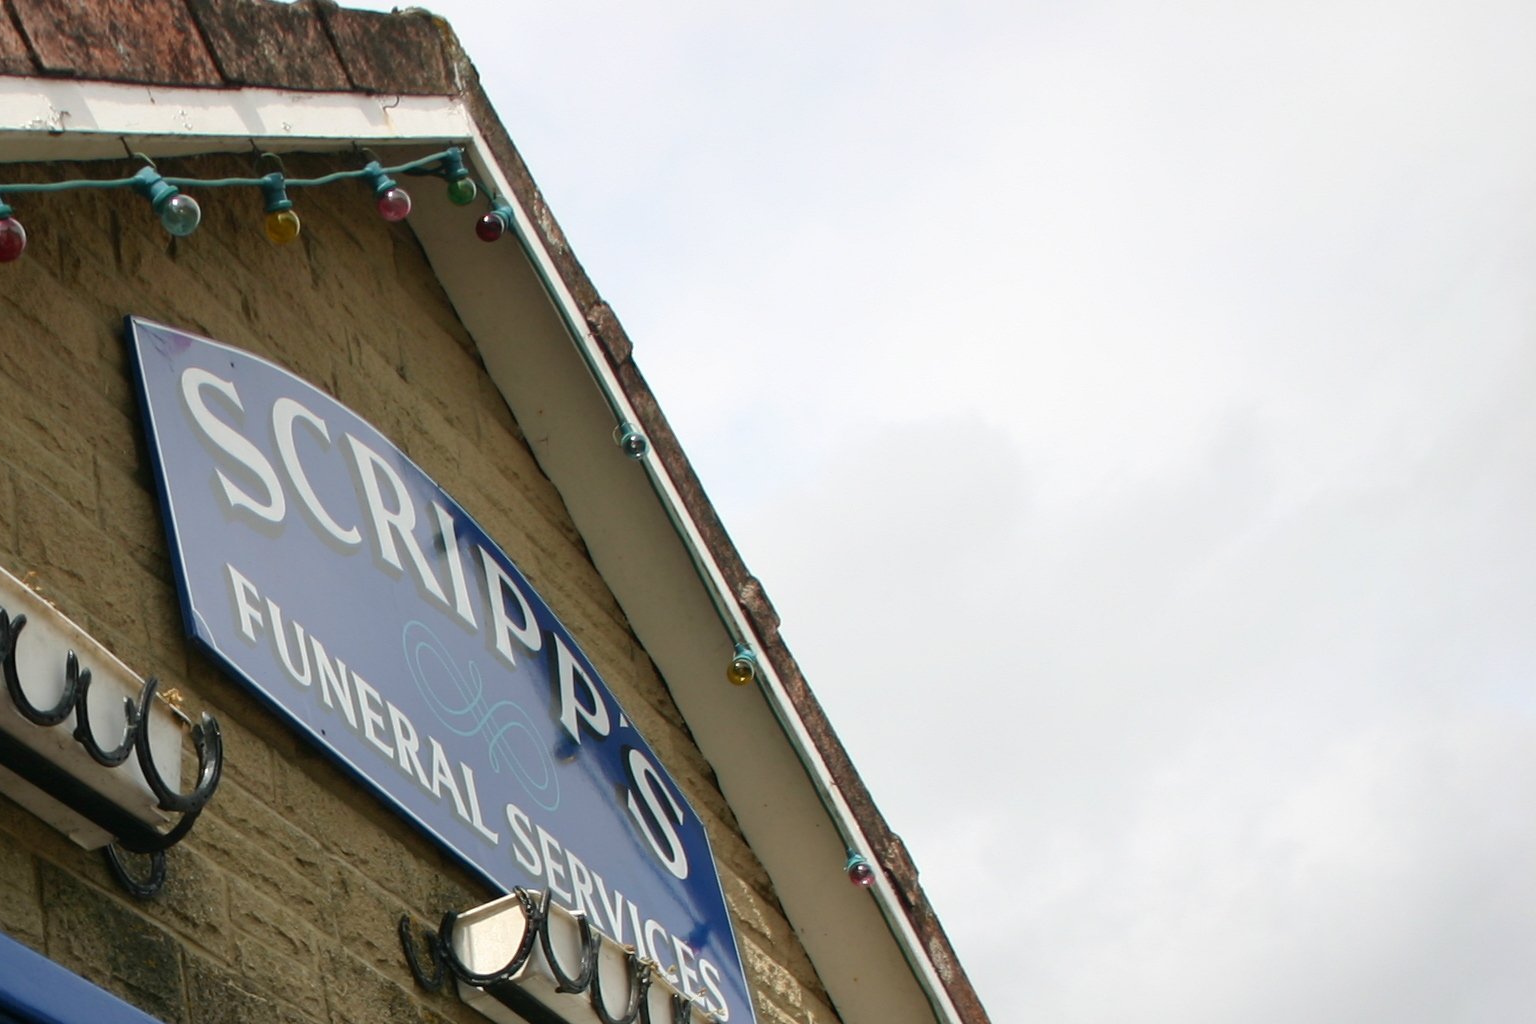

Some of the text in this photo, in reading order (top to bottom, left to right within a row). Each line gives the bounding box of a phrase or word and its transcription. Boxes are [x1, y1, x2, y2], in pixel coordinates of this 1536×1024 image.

[180, 366, 689, 881] SCRIPP'S
[225, 562, 730, 1023] FUNERAL SERVICES
